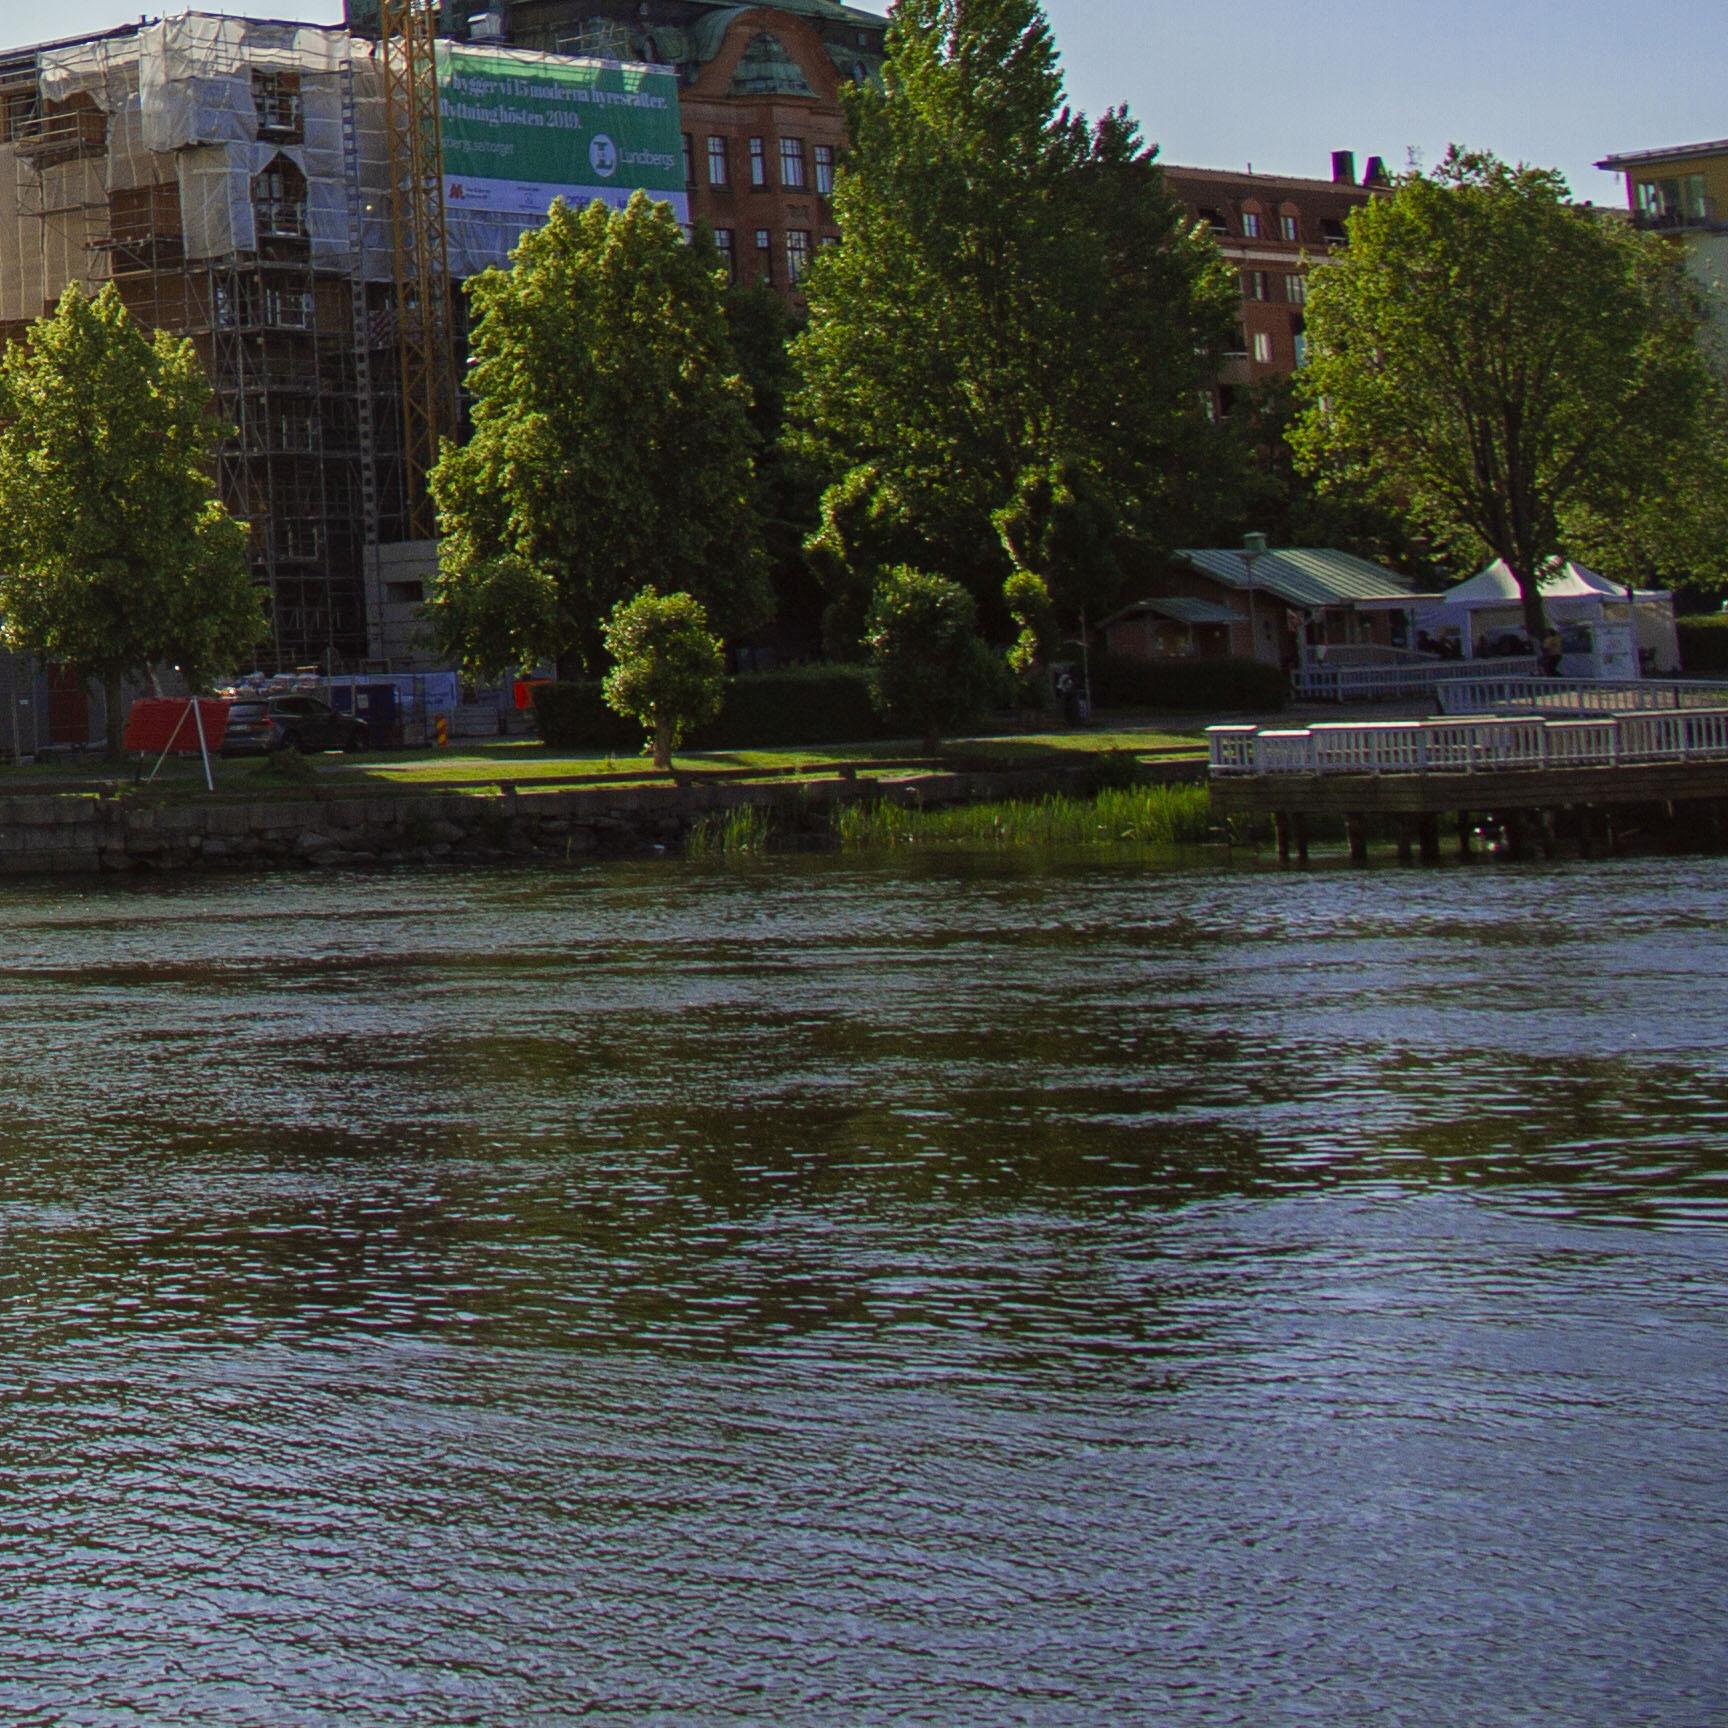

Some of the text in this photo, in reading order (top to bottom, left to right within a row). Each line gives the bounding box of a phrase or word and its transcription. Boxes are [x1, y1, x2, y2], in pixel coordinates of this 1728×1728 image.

[452, 71, 495, 97] bygger
[530, 80, 589, 103] moderna
[619, 147, 676, 170] Lundbergs
